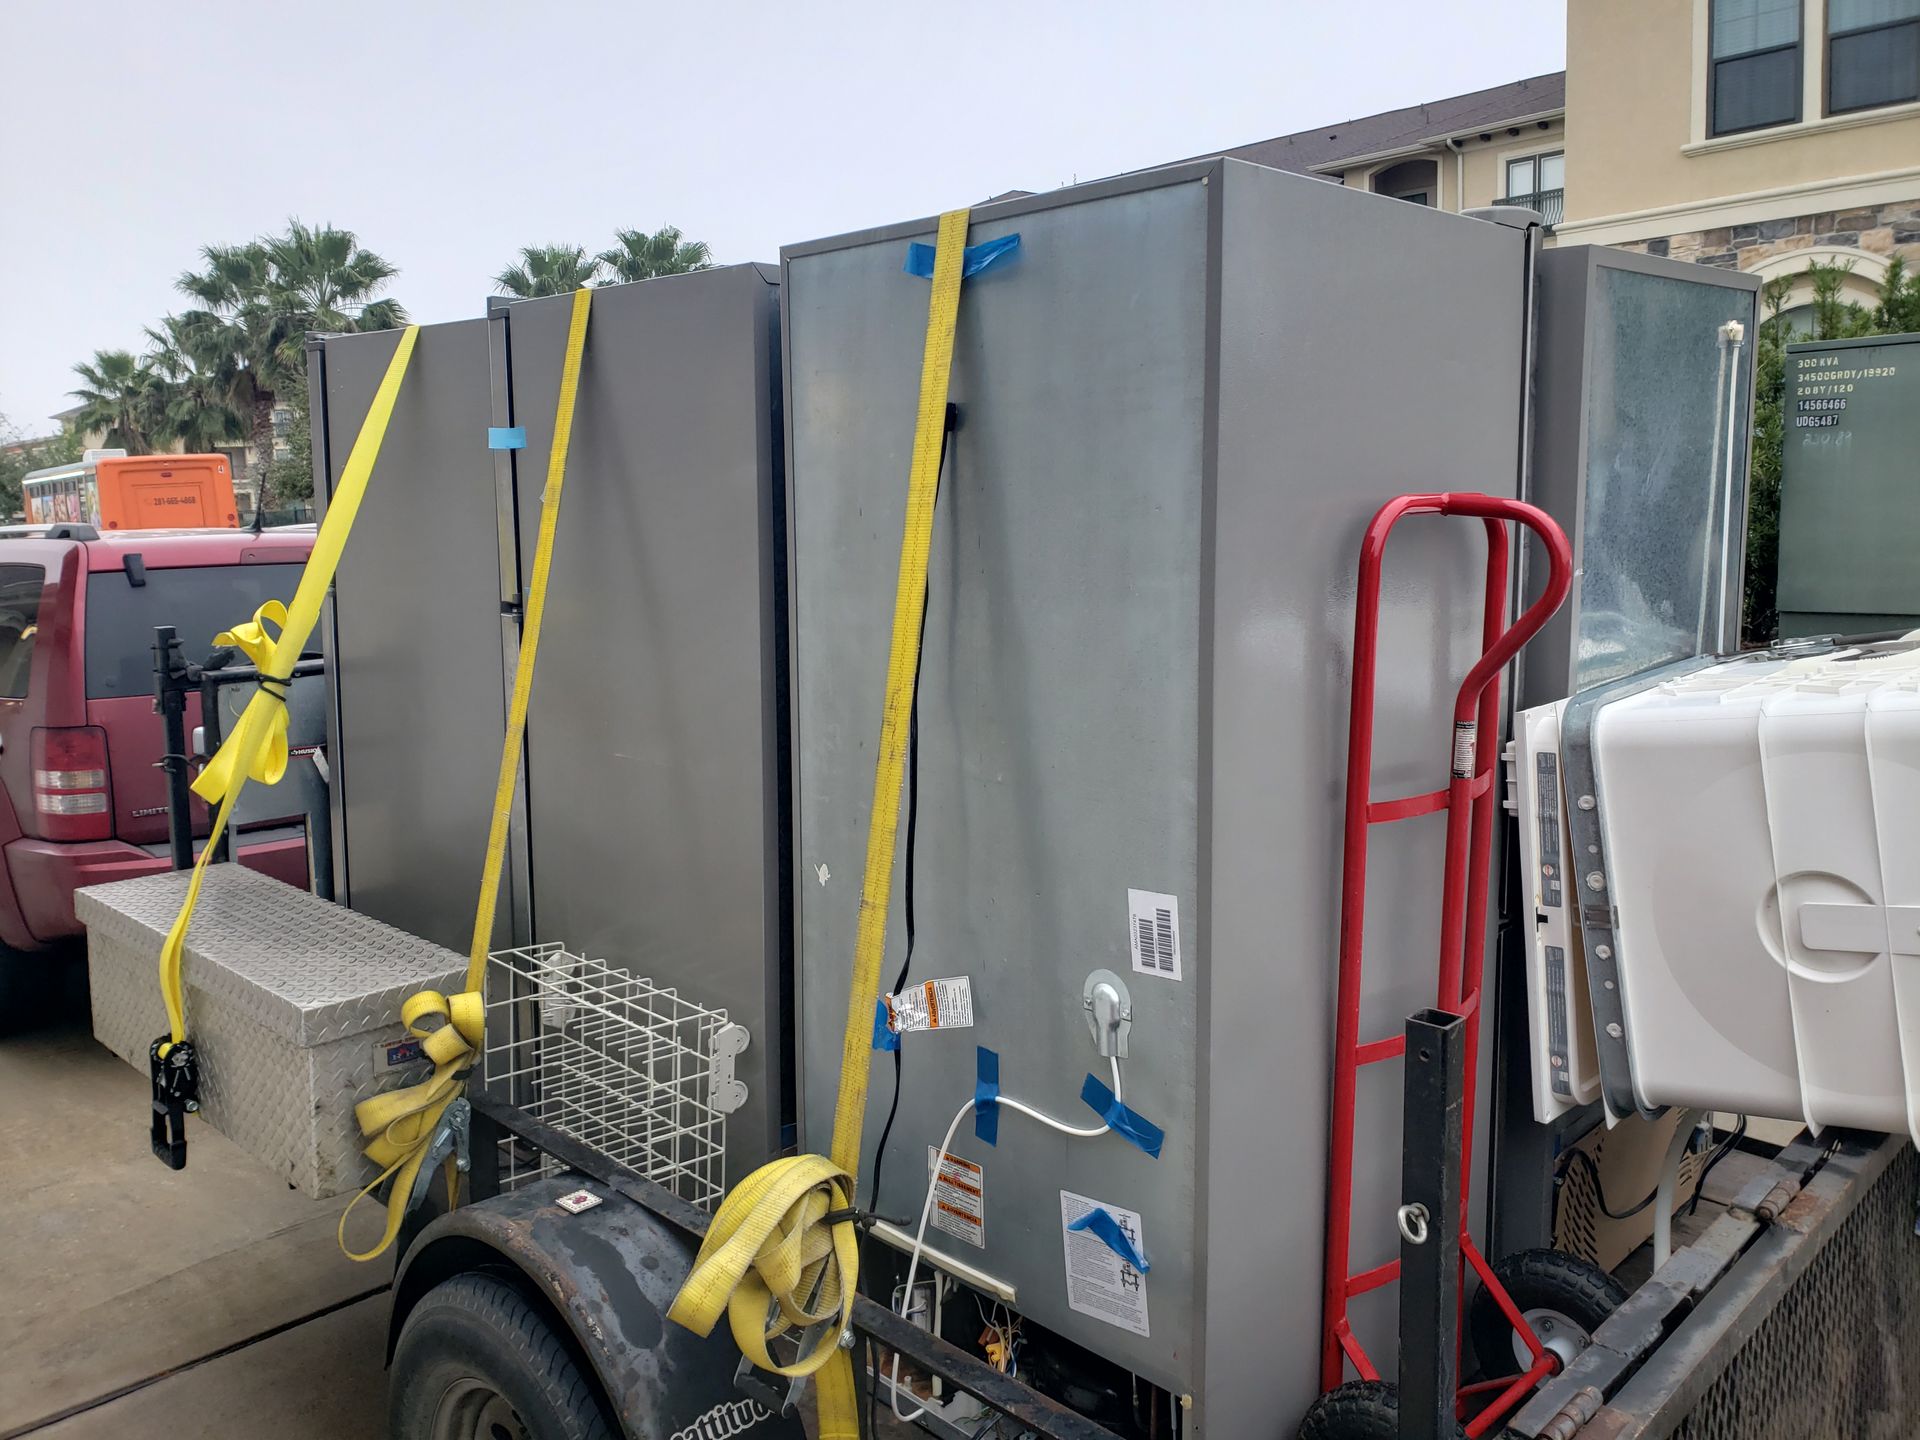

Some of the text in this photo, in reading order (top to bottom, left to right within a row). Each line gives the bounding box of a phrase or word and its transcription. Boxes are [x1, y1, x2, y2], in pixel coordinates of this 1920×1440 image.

[1797, 356, 1839, 368] 300 KVA
[1797, 366, 1896, 382] 34500GRDY/19920
[1797, 384, 1854, 395] 208Y/120
[1798, 399, 1847, 411] 14566466
[1796, 414, 1839, 427] UDG5487
